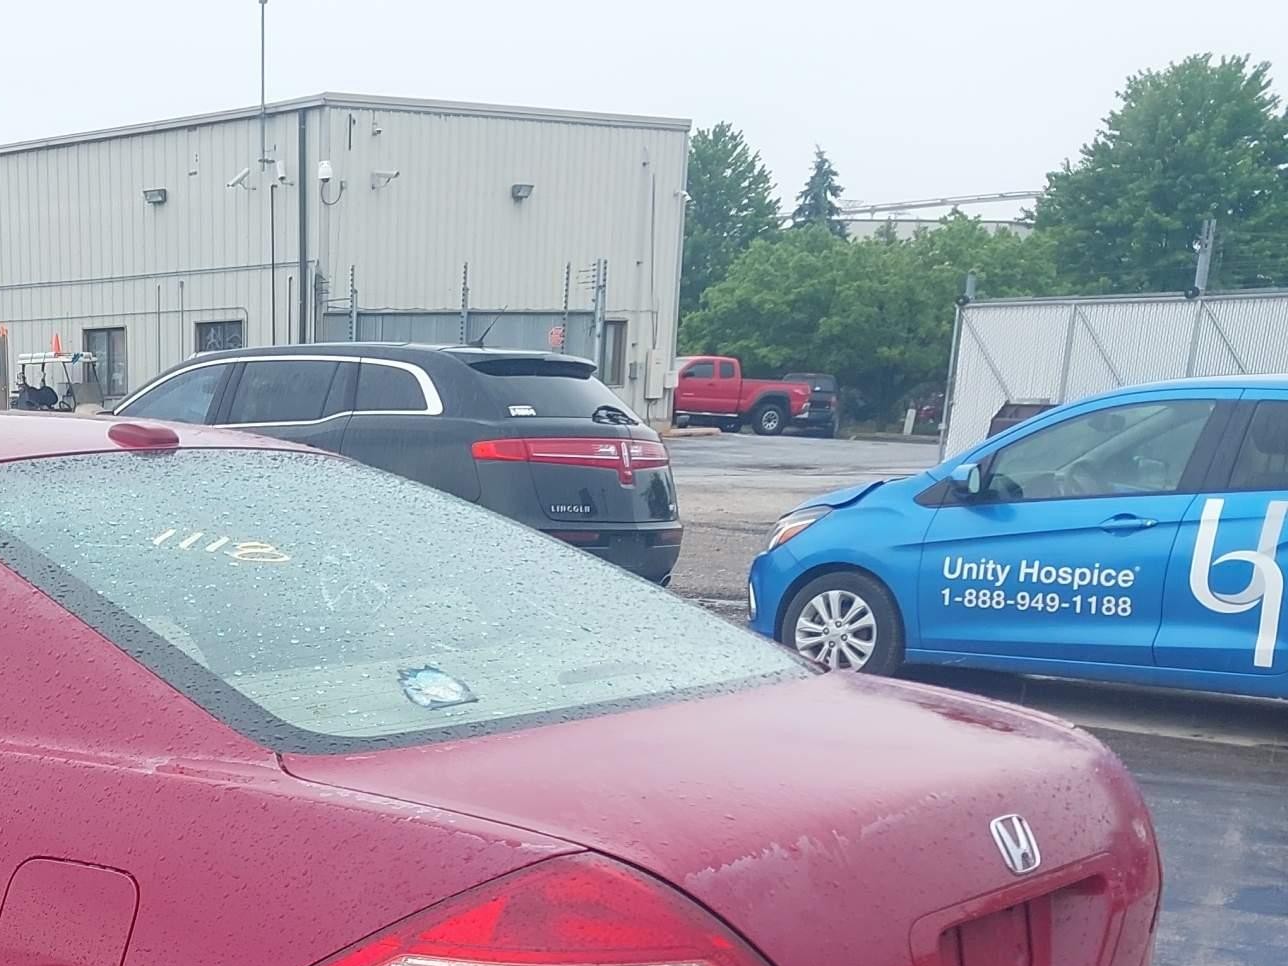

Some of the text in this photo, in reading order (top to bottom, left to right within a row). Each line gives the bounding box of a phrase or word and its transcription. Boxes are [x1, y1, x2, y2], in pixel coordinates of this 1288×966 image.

[551, 504, 591, 513] LINCOLN
[152, 528, 291, 563] 1118
[943, 556, 1136, 590] Unity Hospice
[941, 587, 1133, 617] 1-888-949-1188
